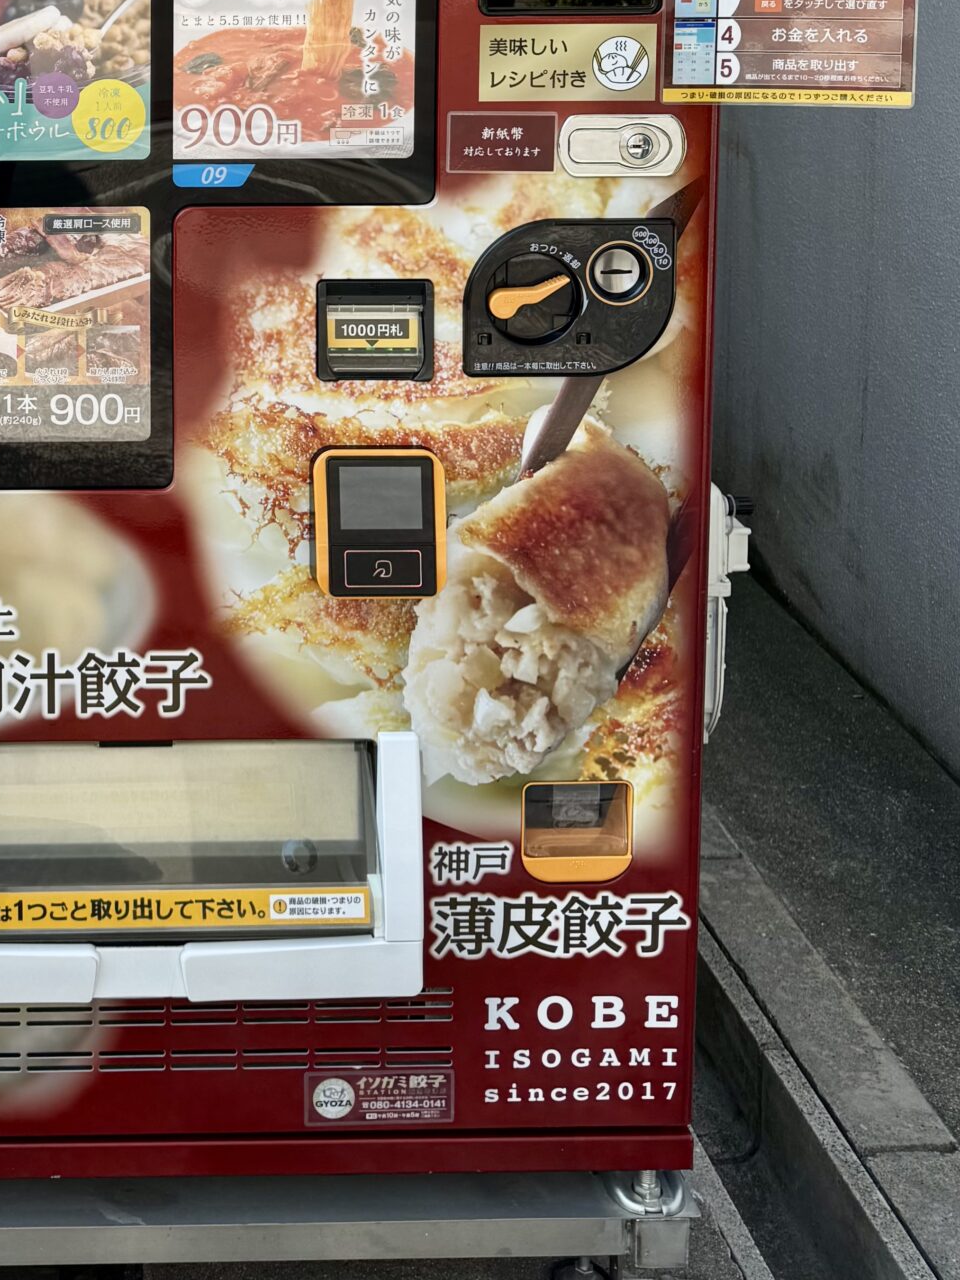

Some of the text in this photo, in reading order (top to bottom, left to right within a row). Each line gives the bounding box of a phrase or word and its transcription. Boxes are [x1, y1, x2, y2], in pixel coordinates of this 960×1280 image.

[761, 0, 888, 10] 戻る をタッチして選び直す
[721, 26, 733, 44] 4
[772, 28, 868, 43] お金を入れる
[488, 37, 568, 57] 美味しい
[720, 59, 733, 78] 5
[772, 59, 859, 71] 商品を取り出す
[489, 69, 587, 89] レシピ付き
[44, 98, 68, 107] 不使用
[481, 127, 524, 141] 新紙幣
[463, 146, 541, 157] 対応しております
[201, 166, 227, 184] 09
[53, 219, 131, 230] 厳選肩ロース使用
[340, 323, 404, 338] 1000円札
[0, 416, 42, 426] (約240g)
[433, 845, 510, 882] 神戸
[288, 906, 346, 916] 原因になります。
[434, 895, 688, 955] 薄皮餃子
[484, 994, 679, 1031] KOBE
[484, 1047, 679, 1070] ISOGAMI
[356, 1075, 447, 1089] イソガミ餃子
[315, 1100, 352, 1108] GYOZA
